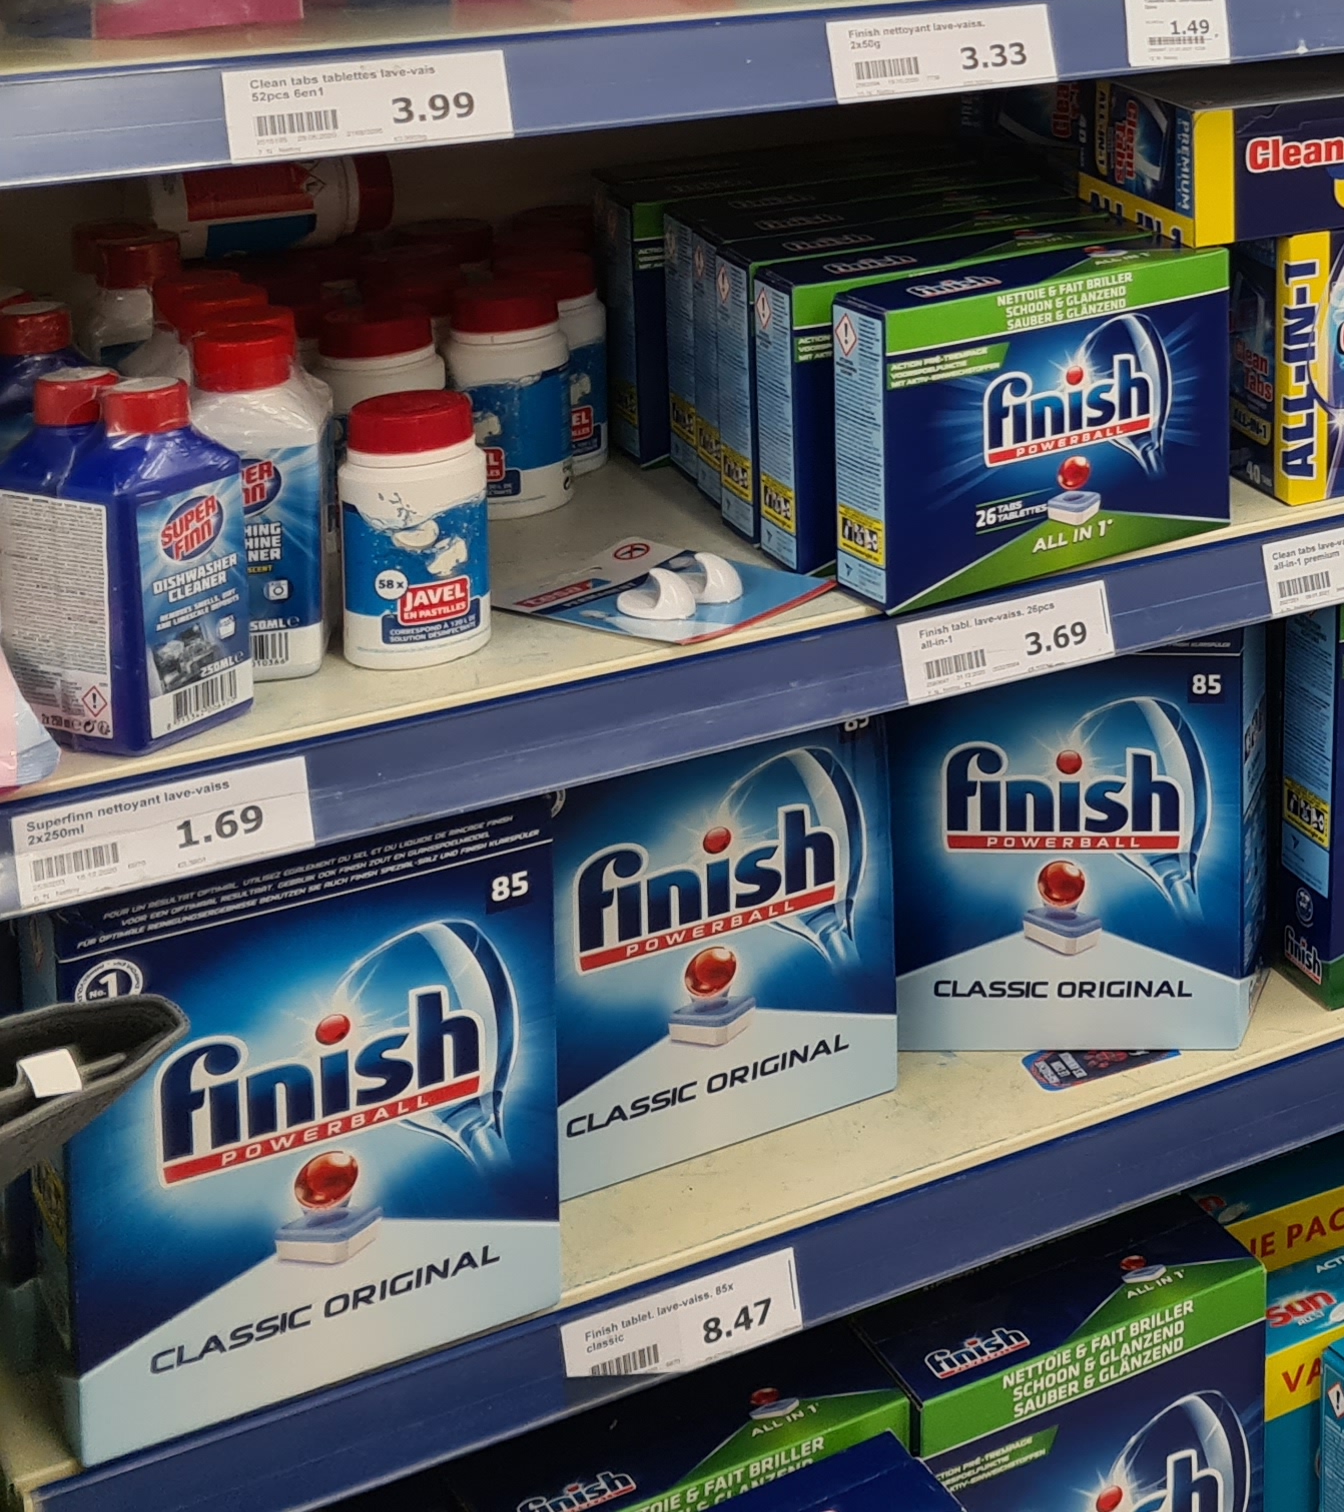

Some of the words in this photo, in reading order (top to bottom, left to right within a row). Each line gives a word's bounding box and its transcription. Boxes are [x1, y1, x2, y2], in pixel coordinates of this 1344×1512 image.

[848, 27, 880, 38] Finish
[883, 22, 932, 37] nettoyant
[933, 19, 985, 33] lave-vaiss.
[849, 39, 881, 51] 2x50g
[960, 41, 1028, 72] 3.33
[250, 76, 287, 90] Clean
[290, 75, 319, 87] tabs
[322, 69, 377, 84] tablettes
[380, 64, 436, 79] lave-vais
[251, 90, 290, 103] 52pcs
[293, 87, 324, 99] 6en1
[391, 91, 476, 125] 3.99
[996, 287, 1045, 307] NETTOIE
[1047, 287, 1058, 299] &
[1059, 282, 1084, 297] FAIT
[1085, 272, 1133, 292] BRILLER
[983, 353, 1153, 455] finish
[1016, 426, 1125, 458] POWERBALL
[976, 507, 996, 528] 26
[1032, 533, 1071, 553] ALL
[1073, 526, 1094, 544] IN
[153, 553, 238, 594] DISHWASHER
[168, 571, 227, 603] CLEANER
[404, 583, 466, 612] JAVEL
[404, 612, 417, 620] EN
[418, 602, 466, 618] PASTILLES
[1025, 622, 1087, 655] 3.69
[25, 807, 93, 834] Superfinn
[96, 793, 163, 820] nettoyant
[164, 779, 230, 805] lave-vaiss
[27, 824, 86, 848] 2x250ml
[176, 805, 265, 851] 1.69
[490, 872, 530, 904] 85
[159, 984, 486, 1170] finish
[219, 1093, 431, 1167] POWERBALL
[148, 1305, 313, 1377] CLASSIC
[323, 1244, 503, 1320] ORIGINAL
[702, 1297, 772, 1344] 8.47
